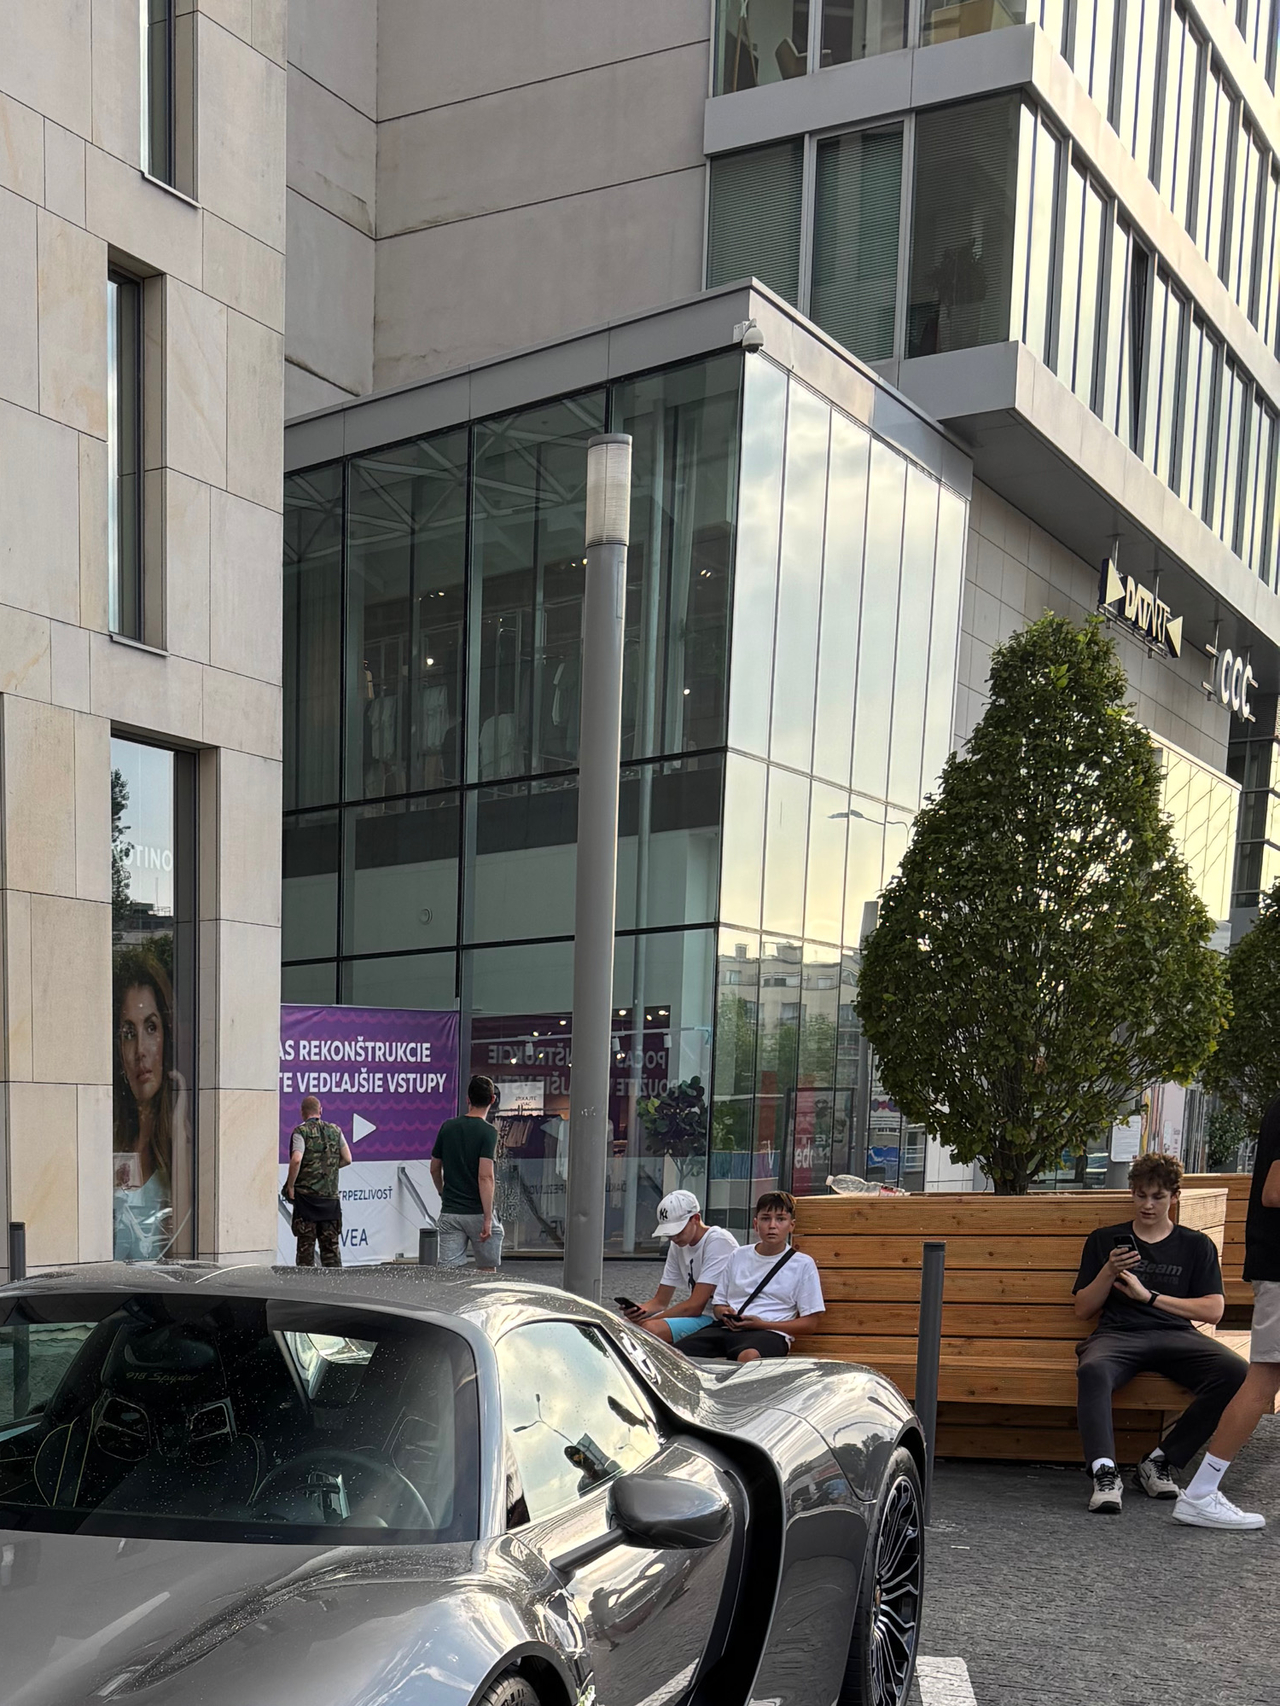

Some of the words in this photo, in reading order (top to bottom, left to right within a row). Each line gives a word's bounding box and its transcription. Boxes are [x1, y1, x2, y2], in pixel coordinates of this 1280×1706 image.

[1221, 648, 1253, 719] CCC
[299, 1036, 431, 1063] REKONŠTRUKCIE
[296, 1068, 384, 1093] VEDĽAJŠIE
[386, 1073, 447, 1093] VSTUPY
